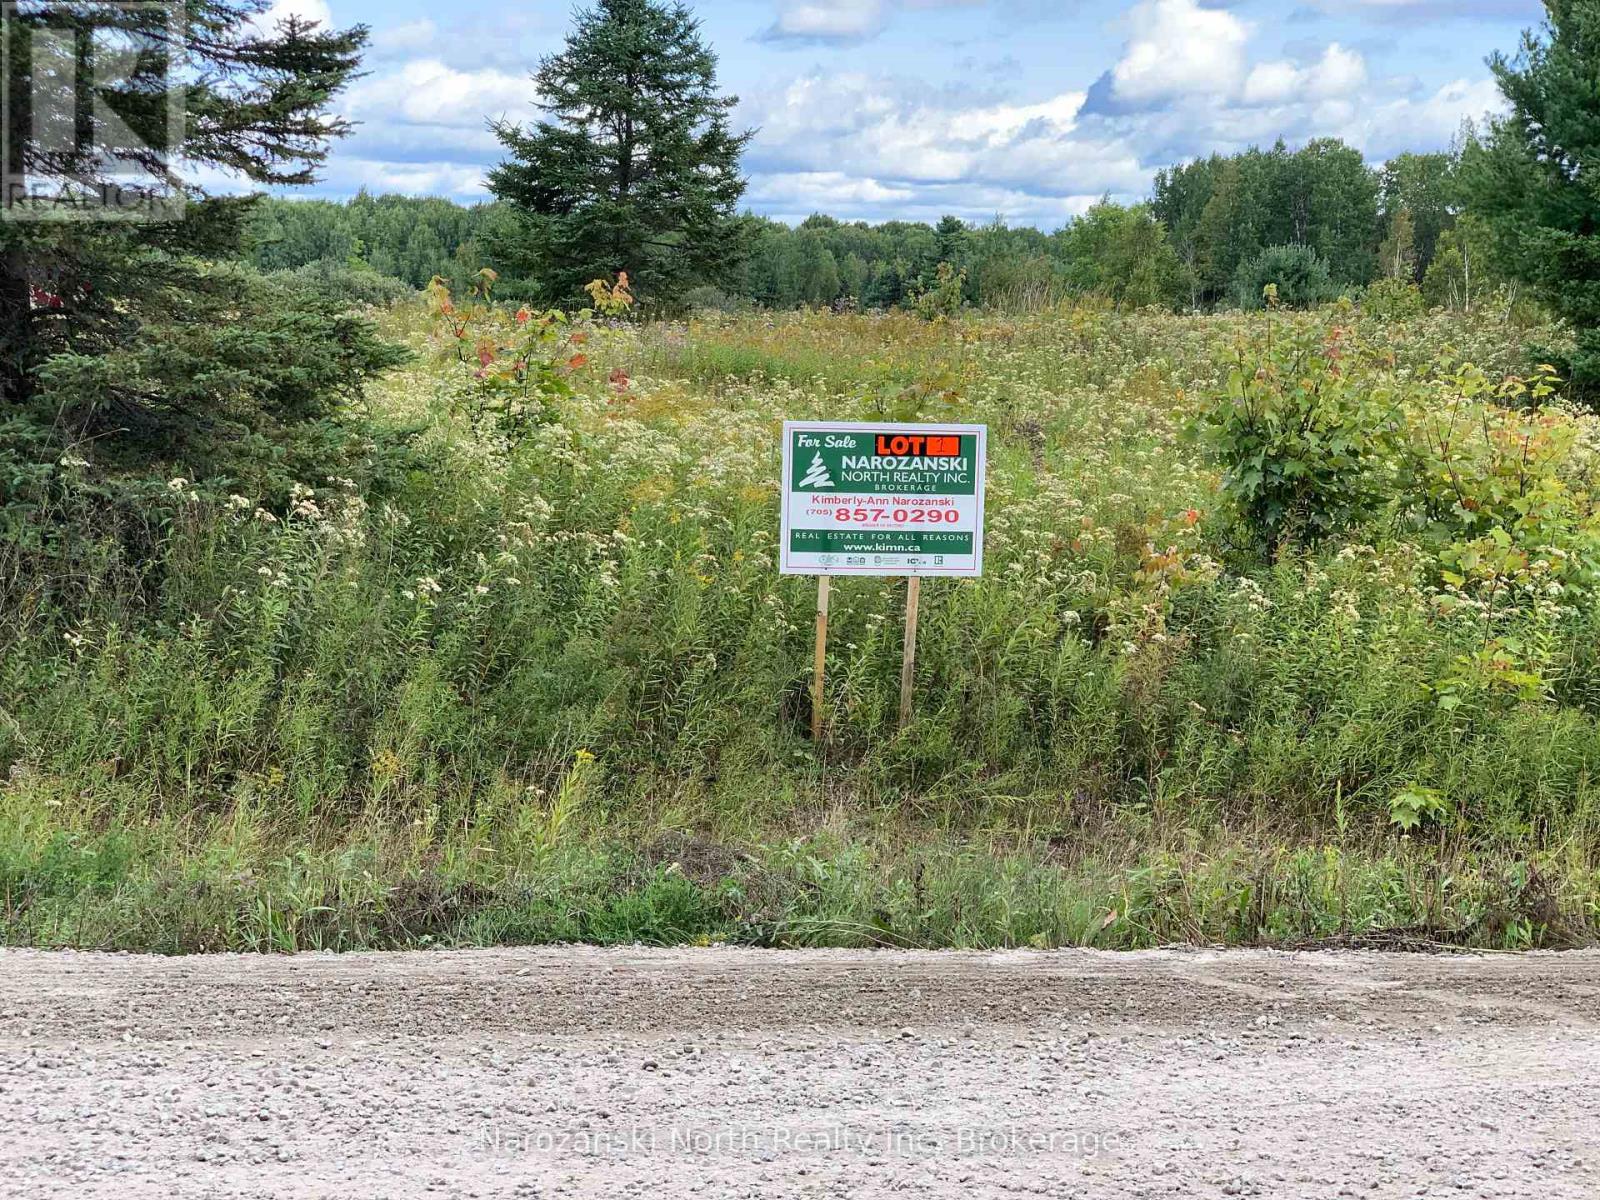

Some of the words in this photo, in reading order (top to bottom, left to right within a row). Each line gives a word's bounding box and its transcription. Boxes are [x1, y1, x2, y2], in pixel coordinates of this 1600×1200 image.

[797, 434, 821, 448] For
[824, 435, 857, 448] Sale
[877, 436, 925, 455] LOT
[841, 455, 968, 471] NAROZANSKI
[841, 471, 890, 483] NORTH
[893, 473, 941, 484] REALTY
[943, 474, 970, 484] INC.
[875, 484, 936, 492] BROKERAGE
[812, 495, 889, 506] Kimberly-Ann
[892, 496, 955, 506] Narozanski
[835, 508, 960, 523] 857-0290
[795, 532, 821, 541] REAL
[827, 533, 864, 541] ESTATE
[871, 534, 891, 542] FOR
[898, 534, 916, 542] ALL
[922, 534, 970, 542] REASONS
[843, 543, 921, 552] www.kimn.ca
